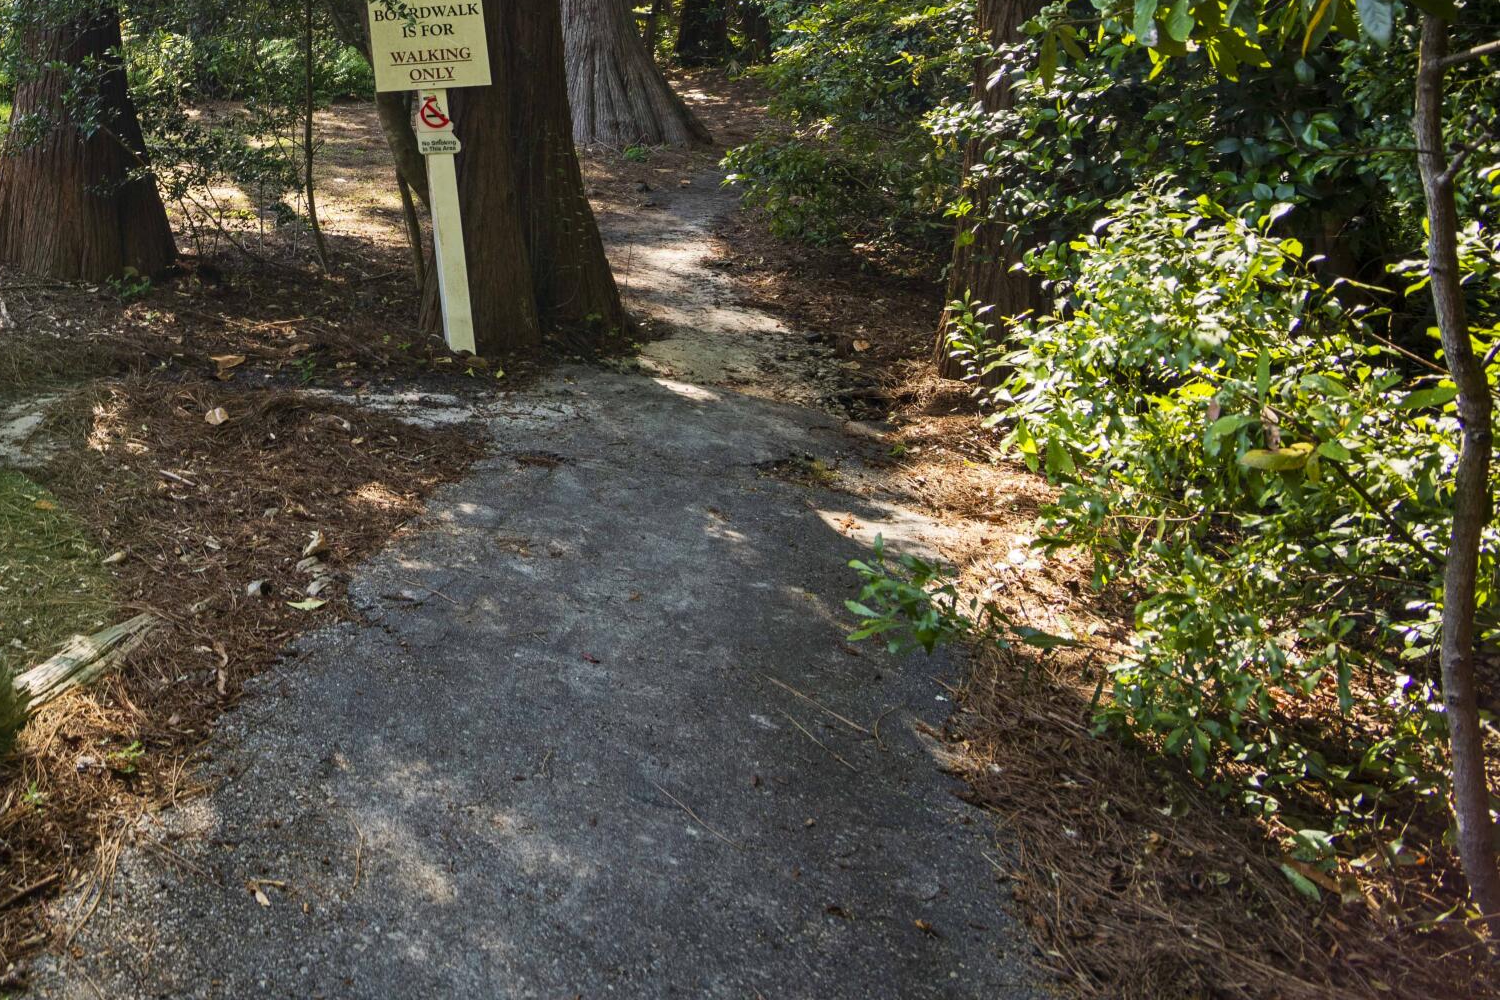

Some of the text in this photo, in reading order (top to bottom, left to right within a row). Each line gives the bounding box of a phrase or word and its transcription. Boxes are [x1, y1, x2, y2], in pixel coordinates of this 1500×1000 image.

[402, 23, 455, 38] IS FOR
[390, 47, 472, 64] WALKING
[409, 66, 455, 81] ONLY
